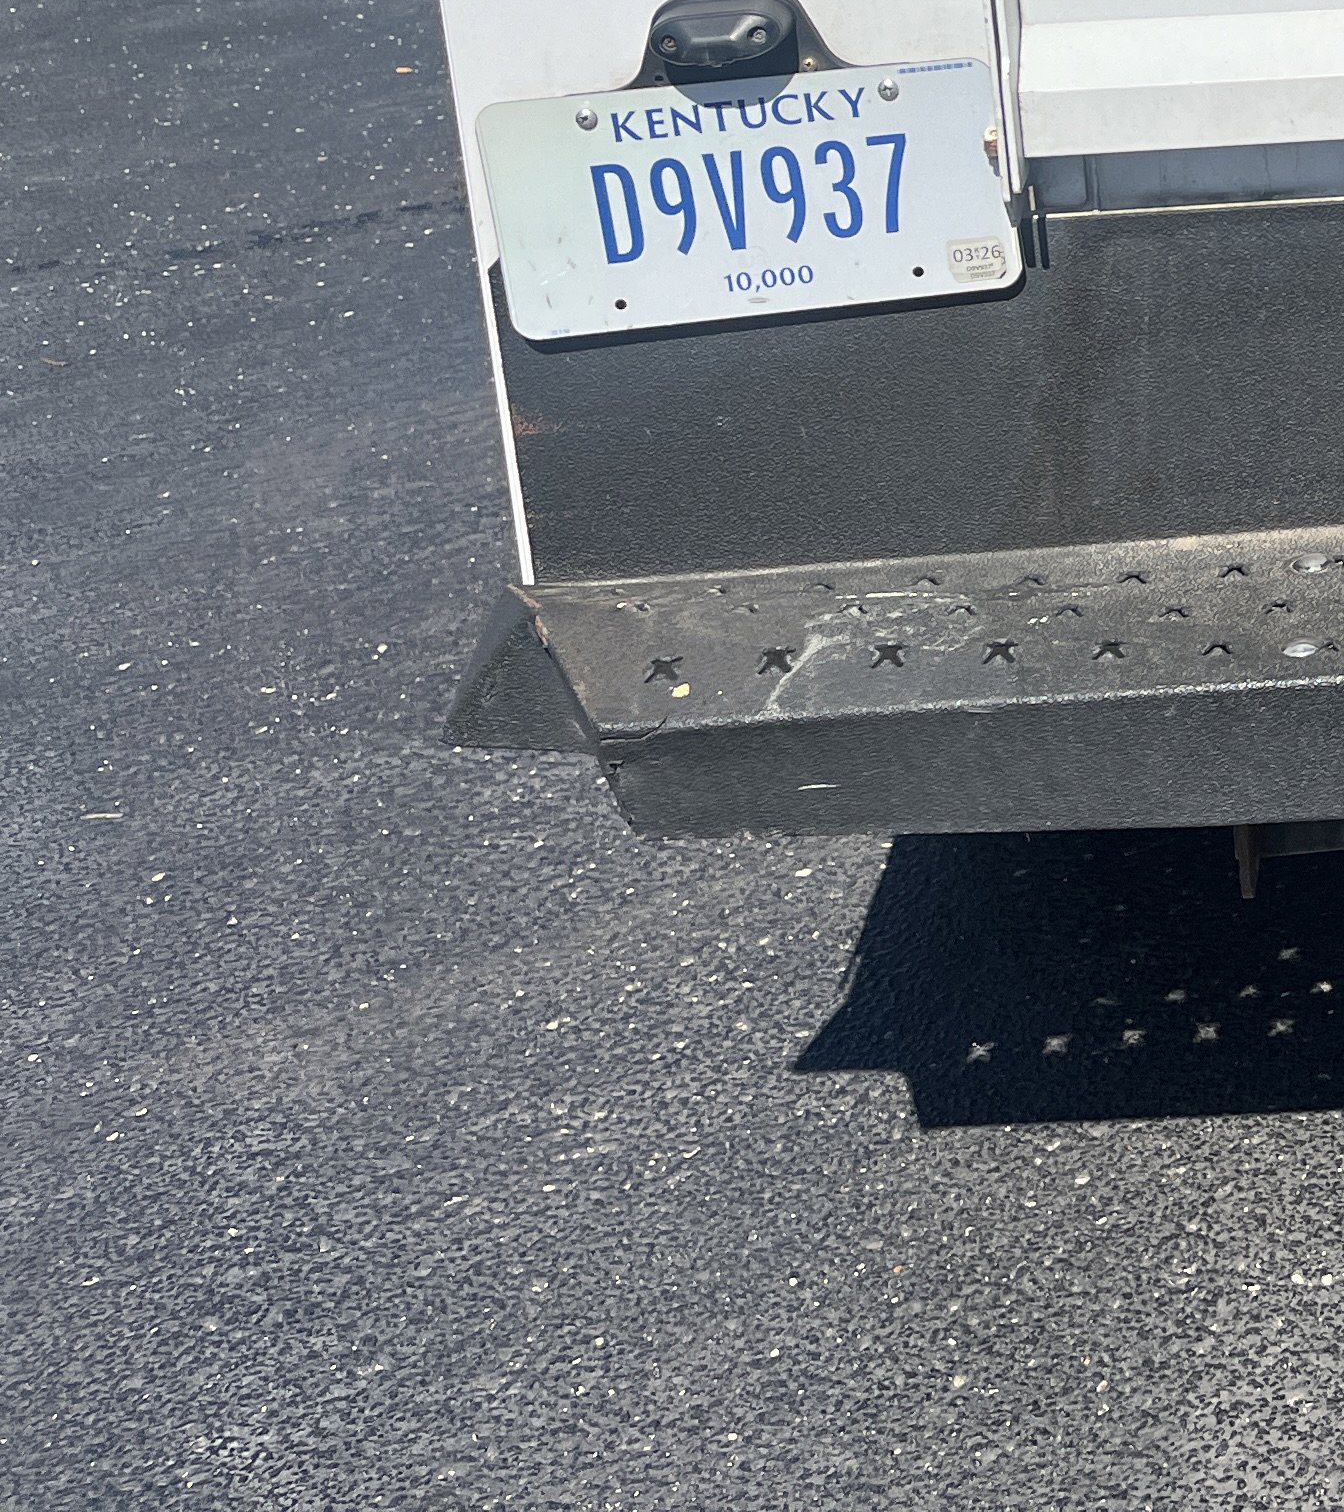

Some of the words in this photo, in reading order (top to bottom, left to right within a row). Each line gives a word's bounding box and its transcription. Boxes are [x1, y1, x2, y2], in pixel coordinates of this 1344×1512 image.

[611, 87, 865, 143] KENTUCKY
[590, 133, 907, 265] D9V937
[953, 248, 973, 262] 03
[981, 245, 1001, 259] 26
[724, 265, 814, 293] 10,000
